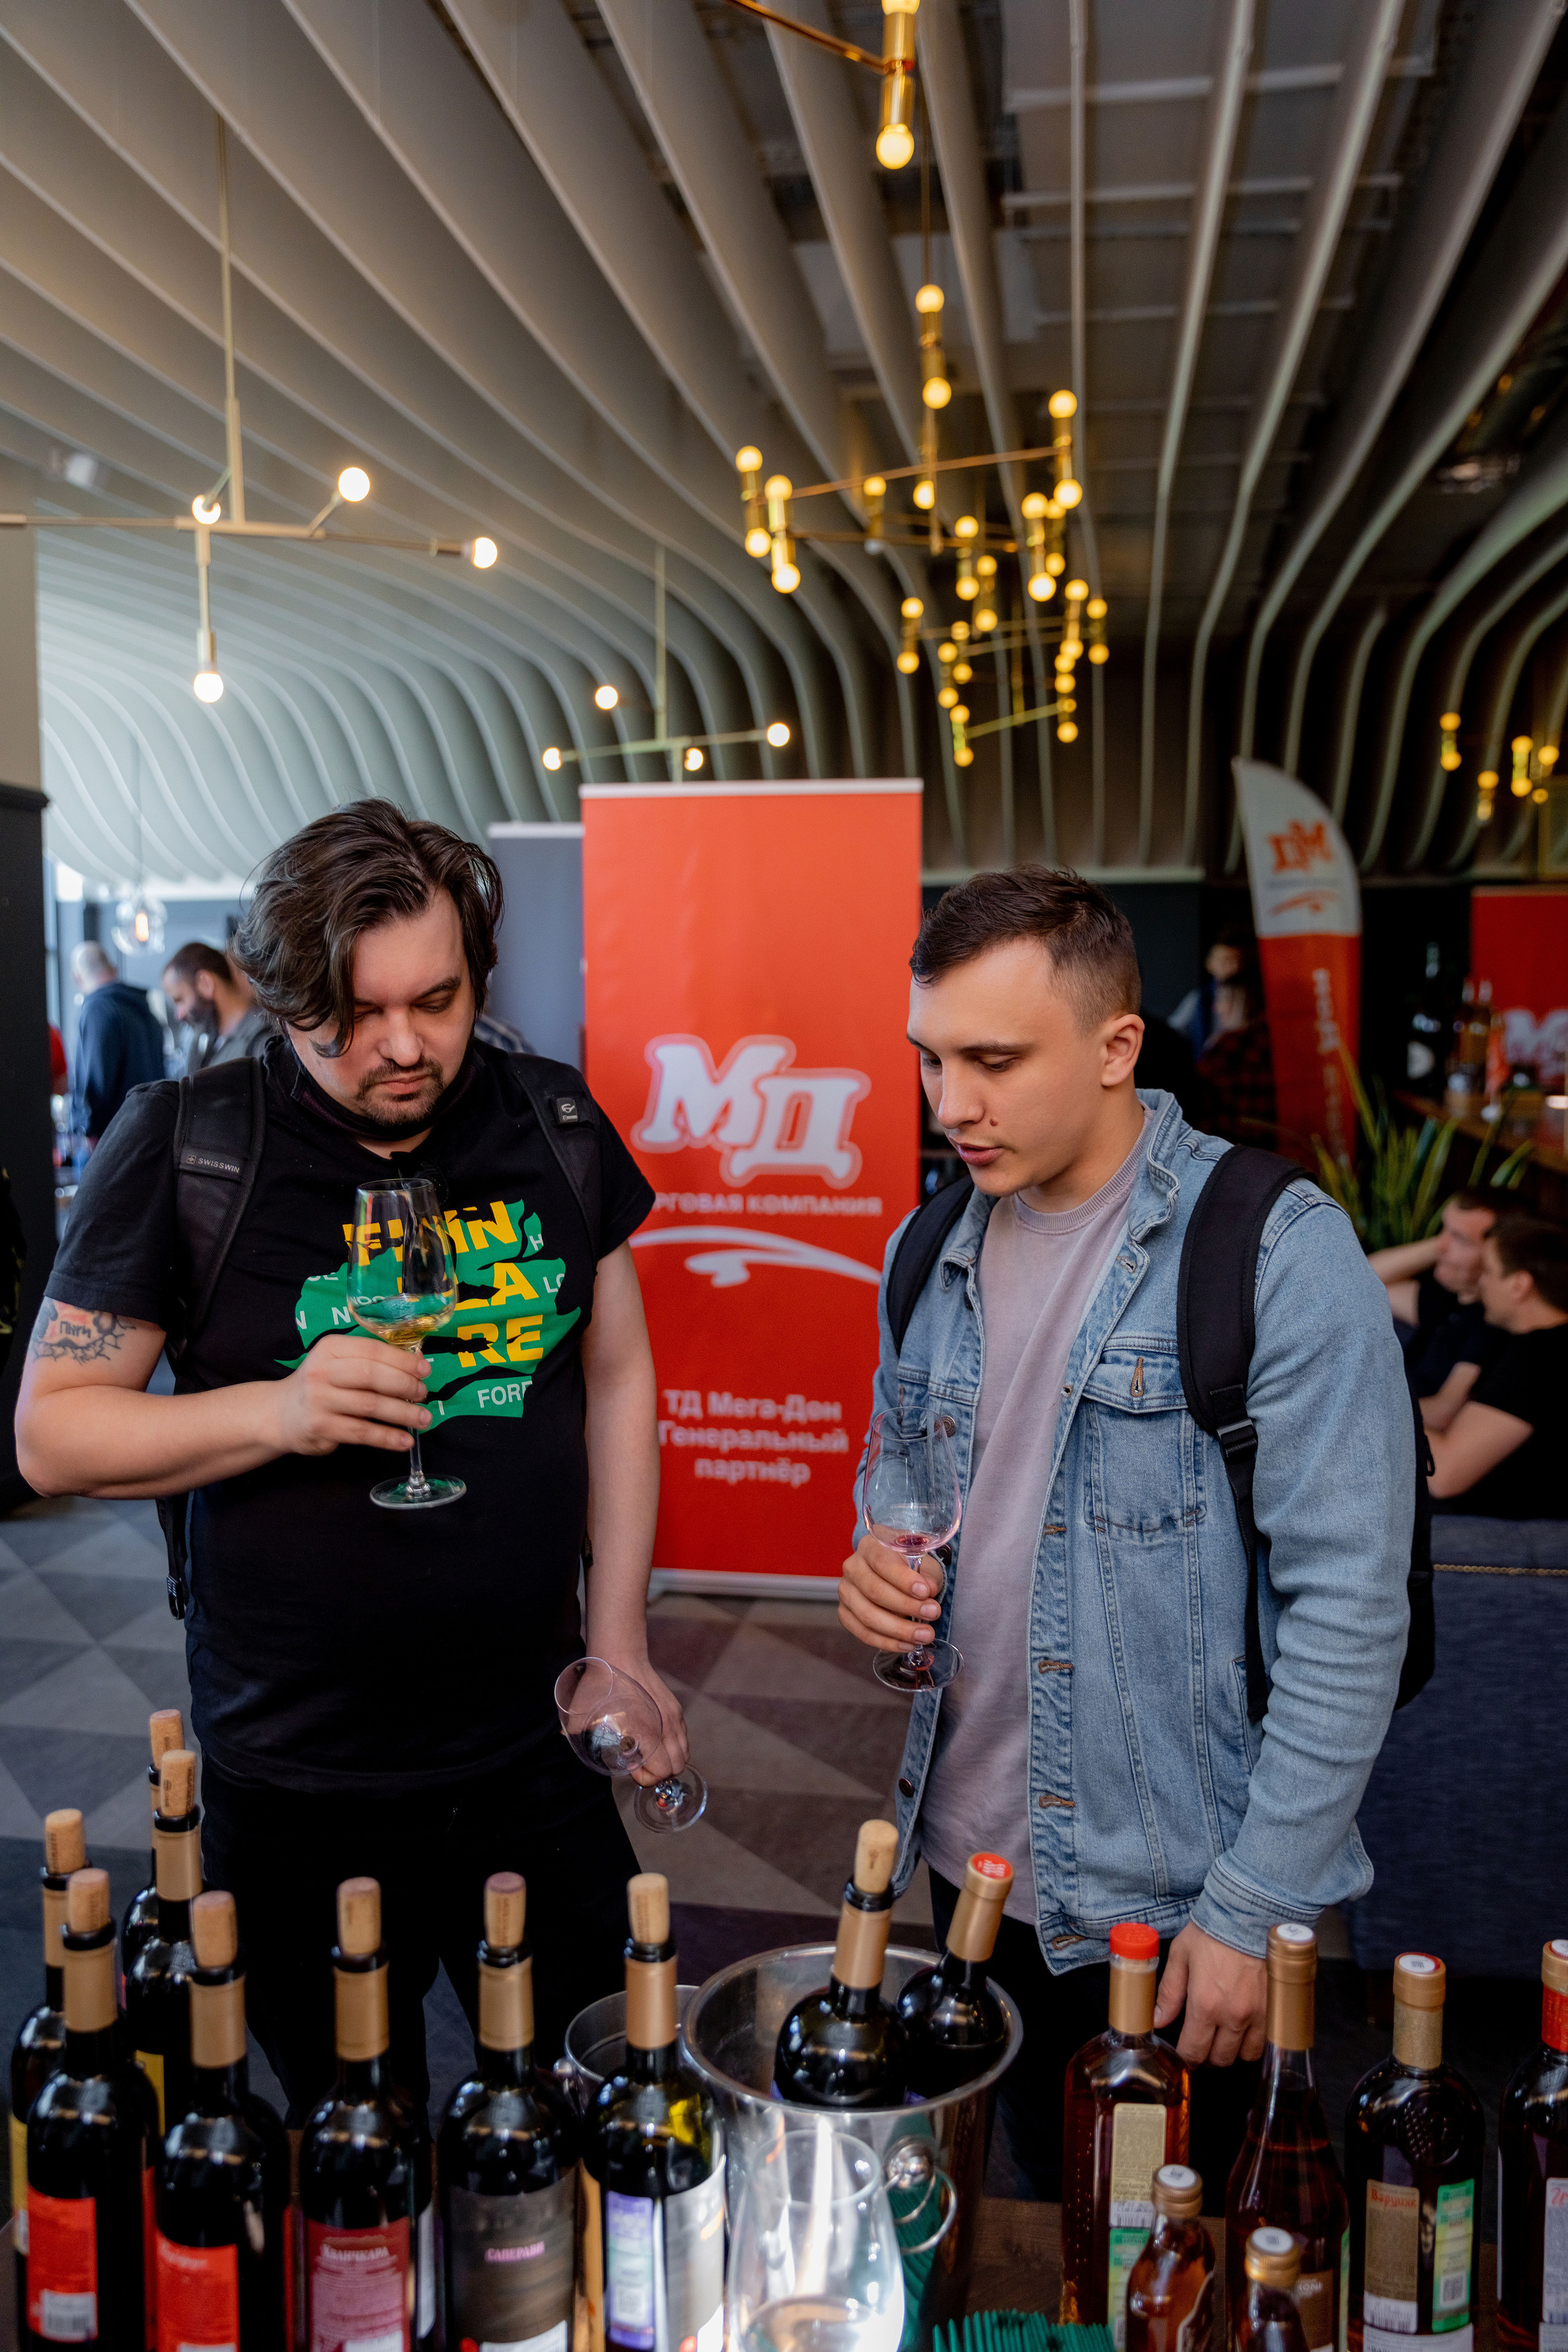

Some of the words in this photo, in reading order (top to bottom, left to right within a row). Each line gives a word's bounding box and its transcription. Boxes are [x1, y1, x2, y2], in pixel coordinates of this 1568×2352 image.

[198, 1158, 240, 1174] SWISSWIN
[654, 1192, 744, 1213] РГОВАЯ
[747, 1194, 882, 1216] КОМПАНИЯ
[663, 1390, 703, 1419] ТД
[708, 1391, 842, 1423] Мега-Дон
[658, 1420, 849, 1453] Генеральный
[695, 1457, 811, 1488] партнёр
